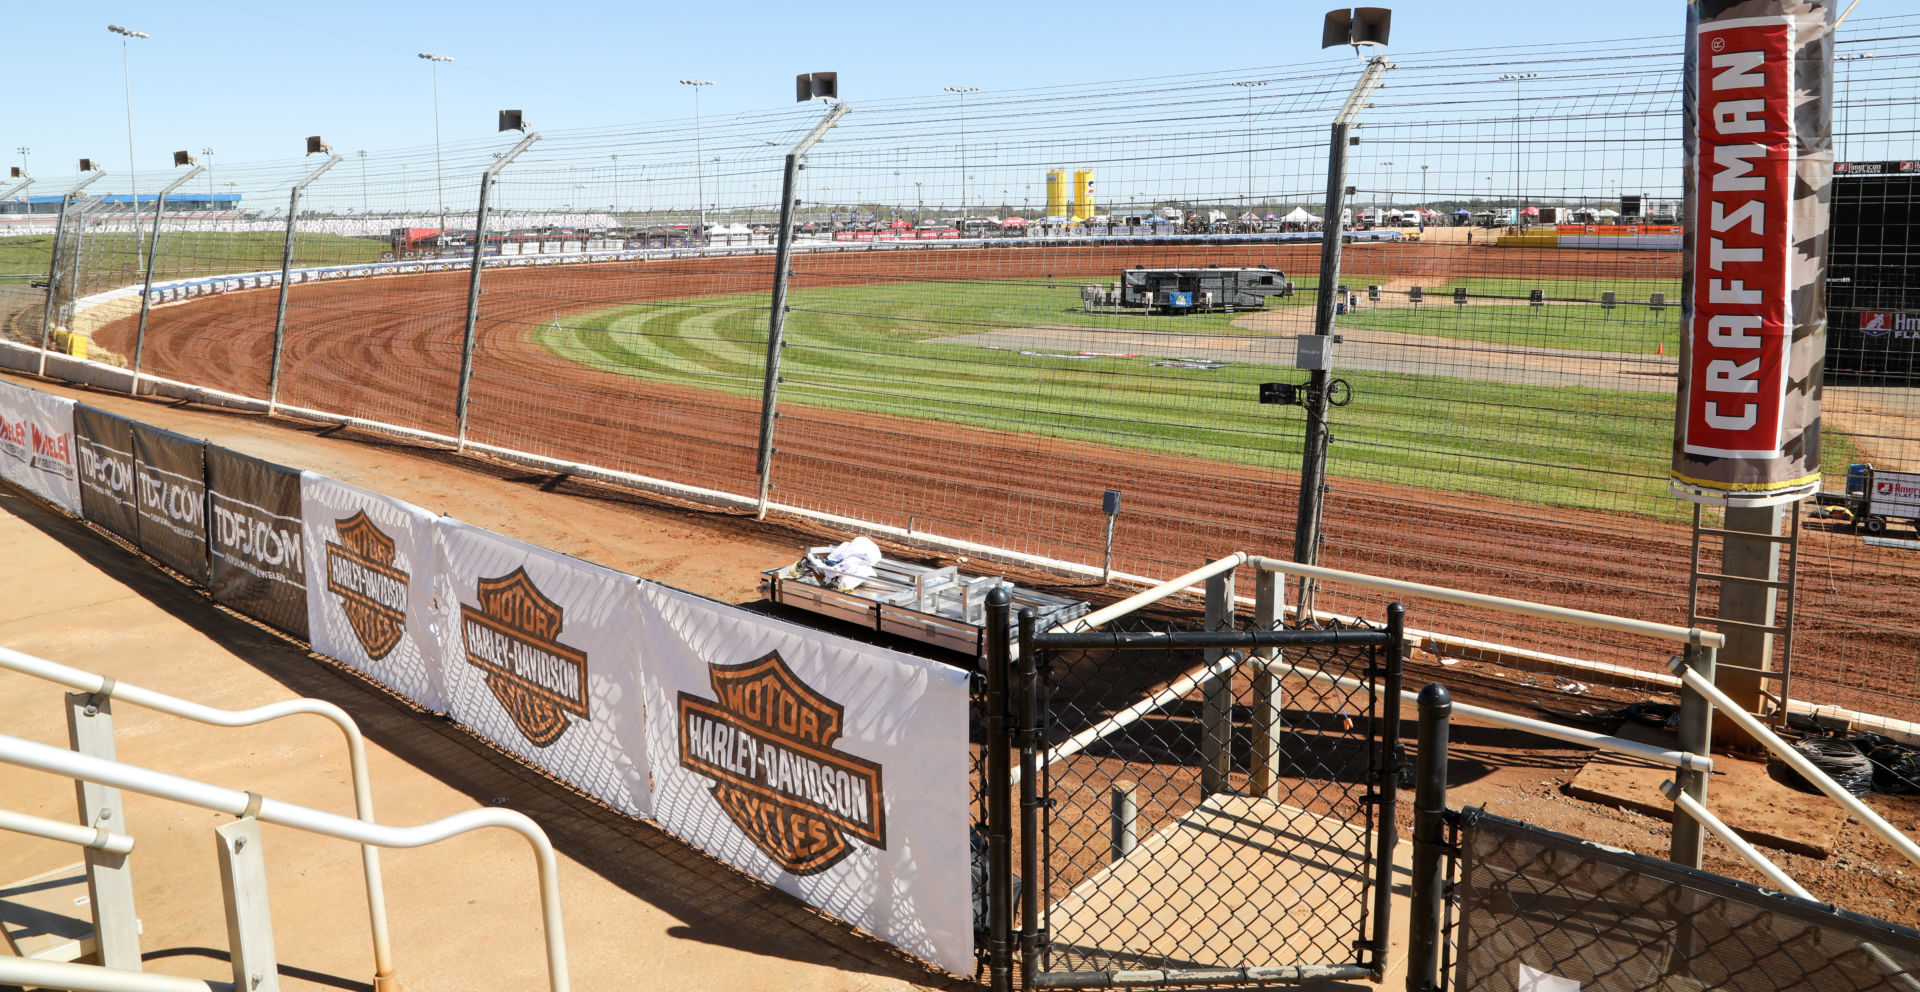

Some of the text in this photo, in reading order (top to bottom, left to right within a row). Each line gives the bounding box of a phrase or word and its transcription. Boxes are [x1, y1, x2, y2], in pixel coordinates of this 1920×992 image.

[1705, 49, 1767, 431] CRAFTSMAN
[214, 504, 302, 574] TDFJ.COM
[331, 553, 408, 614] HARLEY-DAVIDSON
[489, 584, 549, 639] MOTOR
[466, 619, 580, 701] HARLEY-DAVIDSON
[496, 676, 555, 735] CYCLES
[727, 674, 819, 743] MOTOR
[689, 713, 869, 825] HARLEY-DAVIDSON
[729, 787, 829, 859] CYCLES
